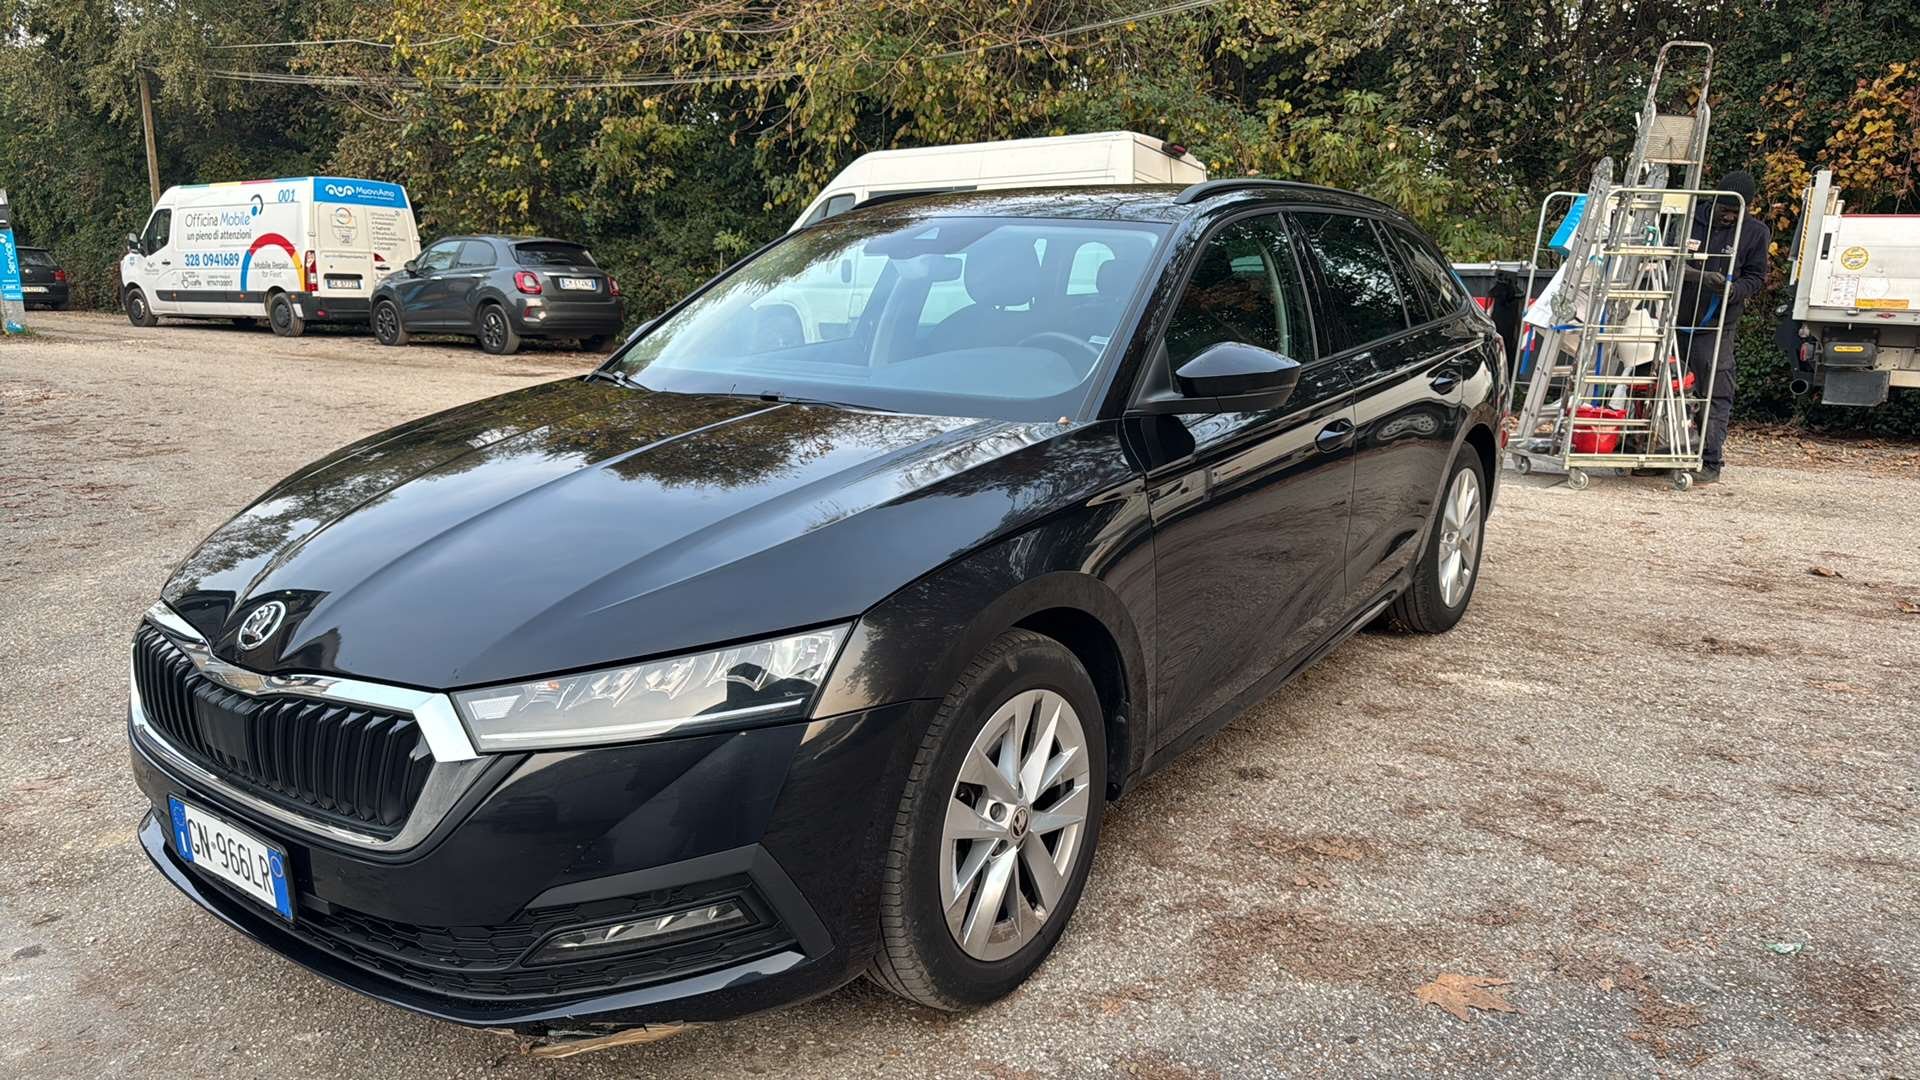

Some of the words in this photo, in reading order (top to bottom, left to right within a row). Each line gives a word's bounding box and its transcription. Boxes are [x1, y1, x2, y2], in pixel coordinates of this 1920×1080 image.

[277, 189, 296, 202] 001
[185, 212, 218, 227] Officina
[219, 211, 251, 226] Mobile
[195, 231, 212, 242] pieno
[213, 230, 219, 240] di
[219, 229, 252, 240] attenzioni
[4, 242, 16, 274] Service
[184, 253, 200, 266] 328
[202, 253, 240, 266] 0941689
[254, 261, 271, 269] Mobile
[272, 261, 289, 270] Repair
